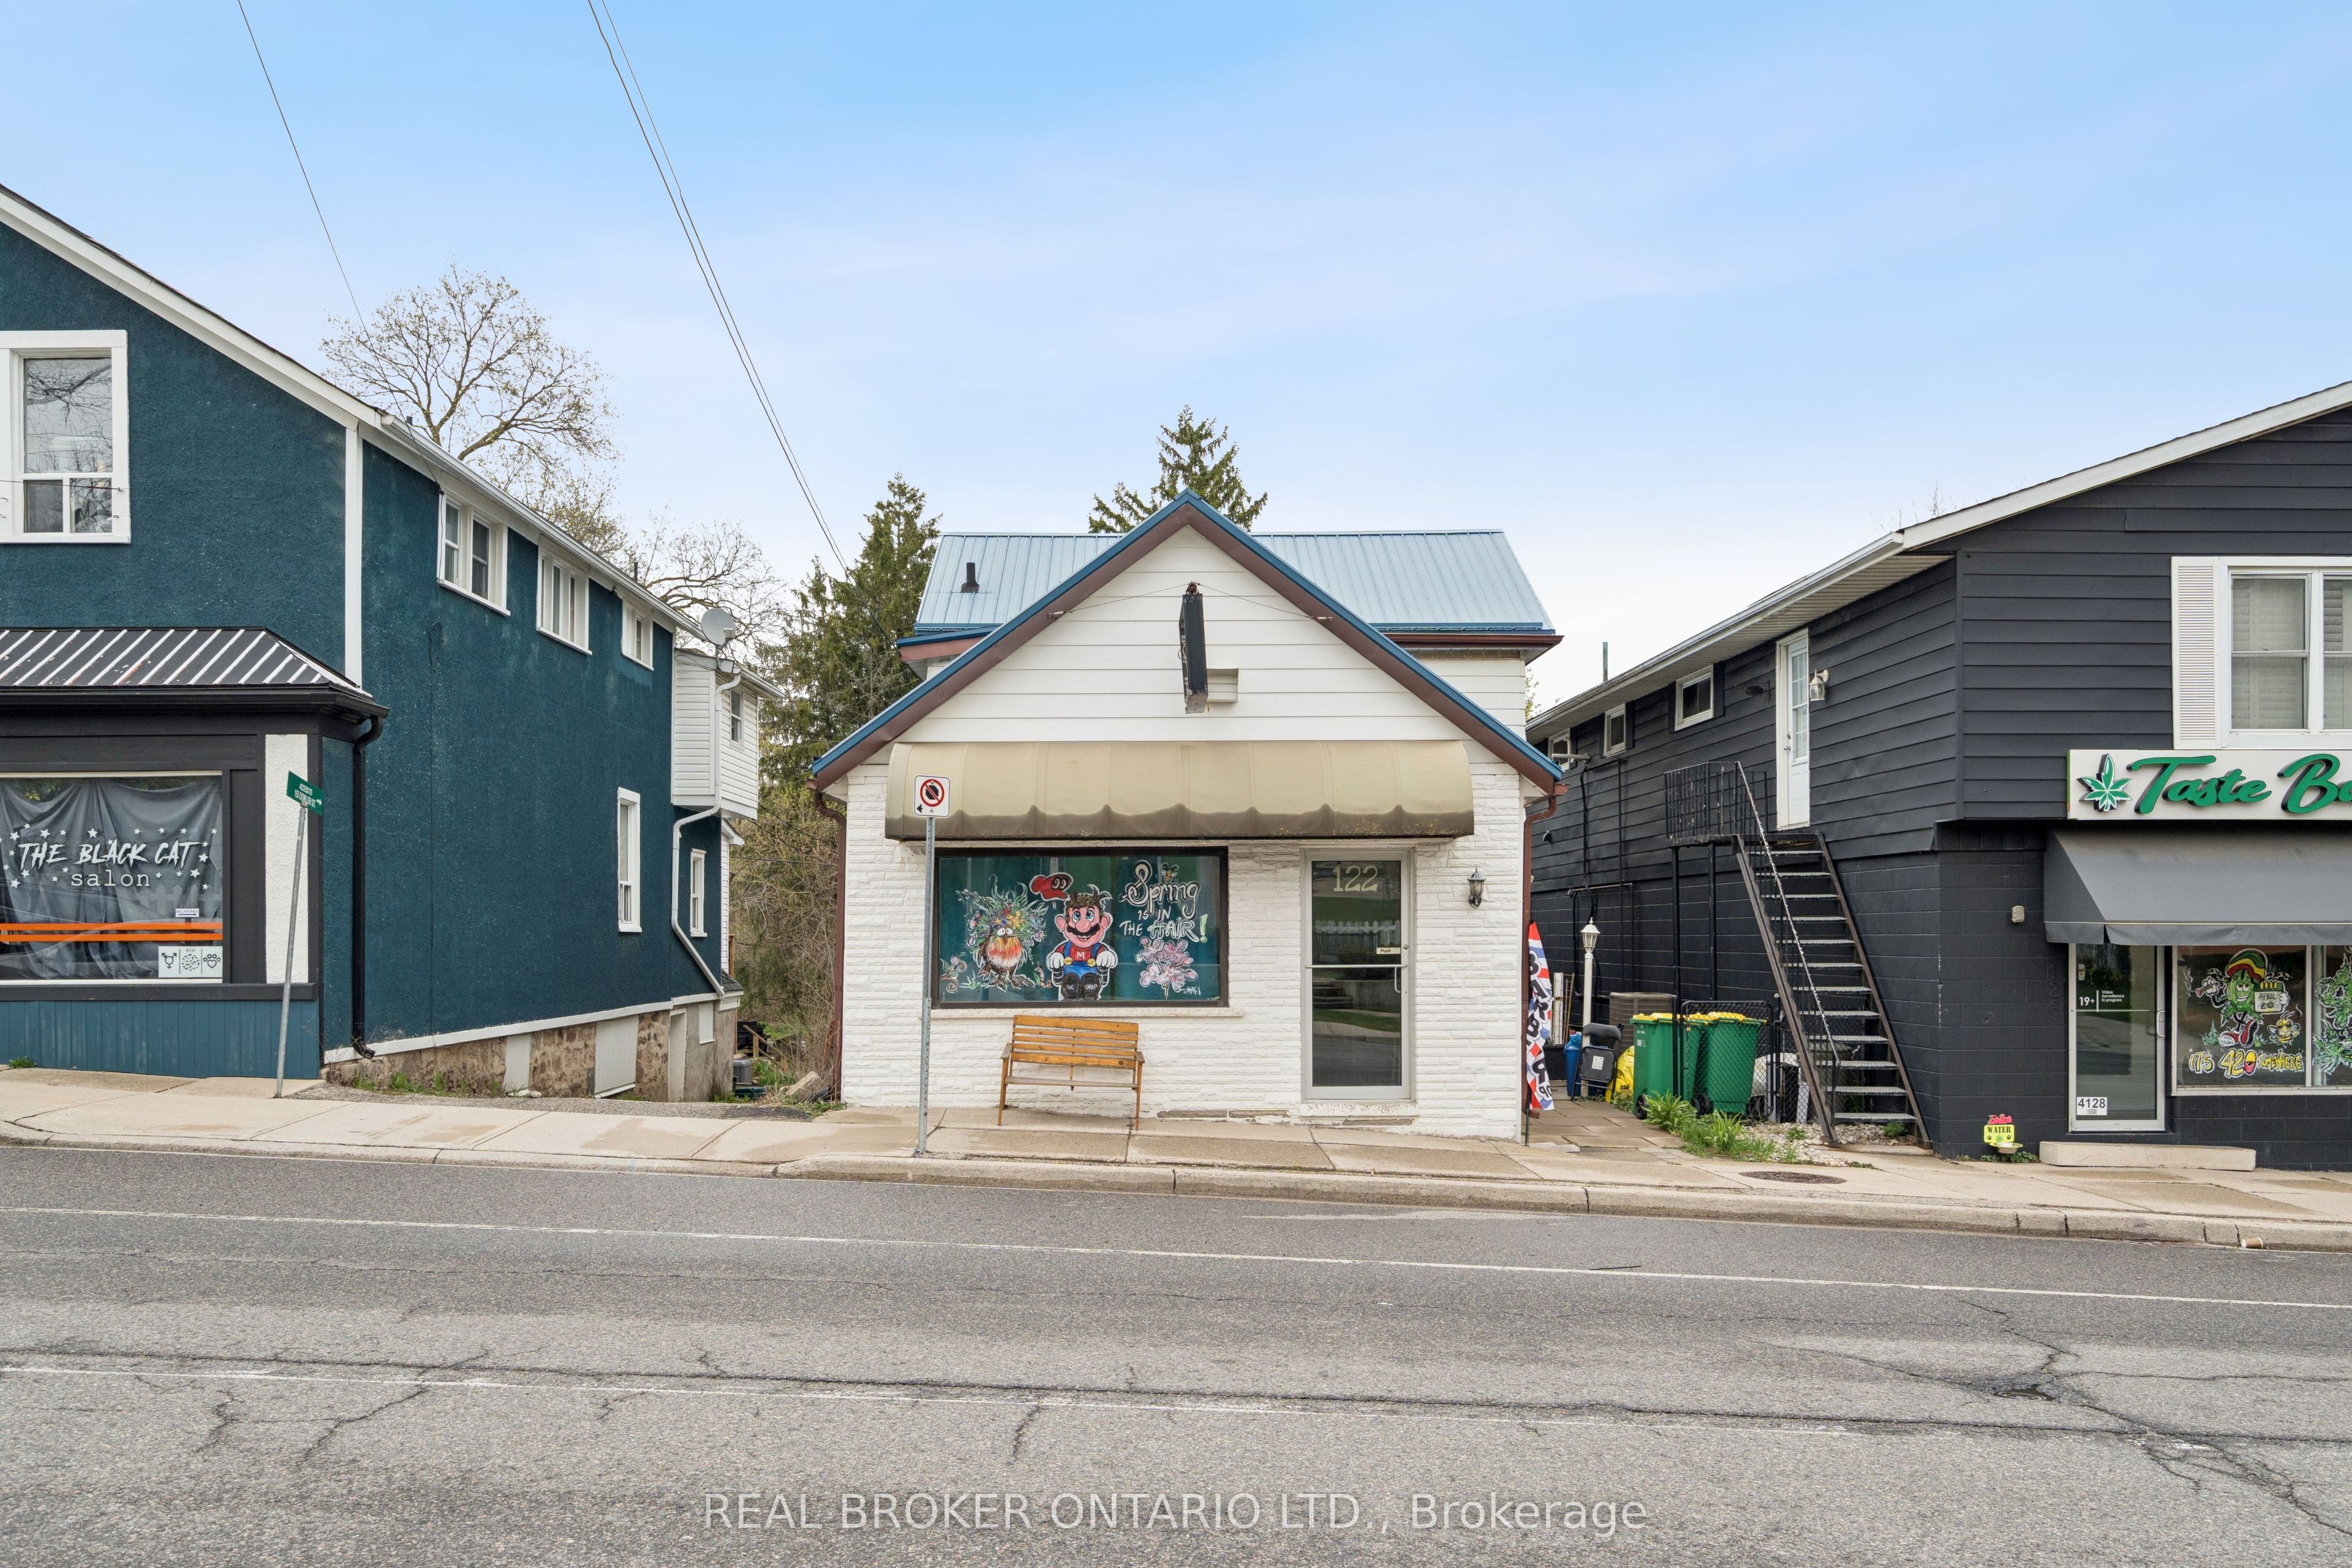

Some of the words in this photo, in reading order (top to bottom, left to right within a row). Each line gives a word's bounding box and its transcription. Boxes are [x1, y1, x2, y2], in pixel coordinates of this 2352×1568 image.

[300, 783, 309, 794] ACCESS
[2126, 755, 2272, 815] Taste
[18, 841, 69, 870] THE
[72, 839, 150, 868] BLACK
[154, 839, 203, 869] CAT
[71, 869, 150, 887] salon
[1333, 865, 1378, 892] 122
[1119, 859, 1200, 920] Spring
[1158, 906, 1171, 920] IN
[1119, 921, 1142, 937] THE
[2079, 997, 2095, 1006] 19+
[2218, 1048, 2258, 1079] 420
[2078, 1098, 2105, 1108] 4128
